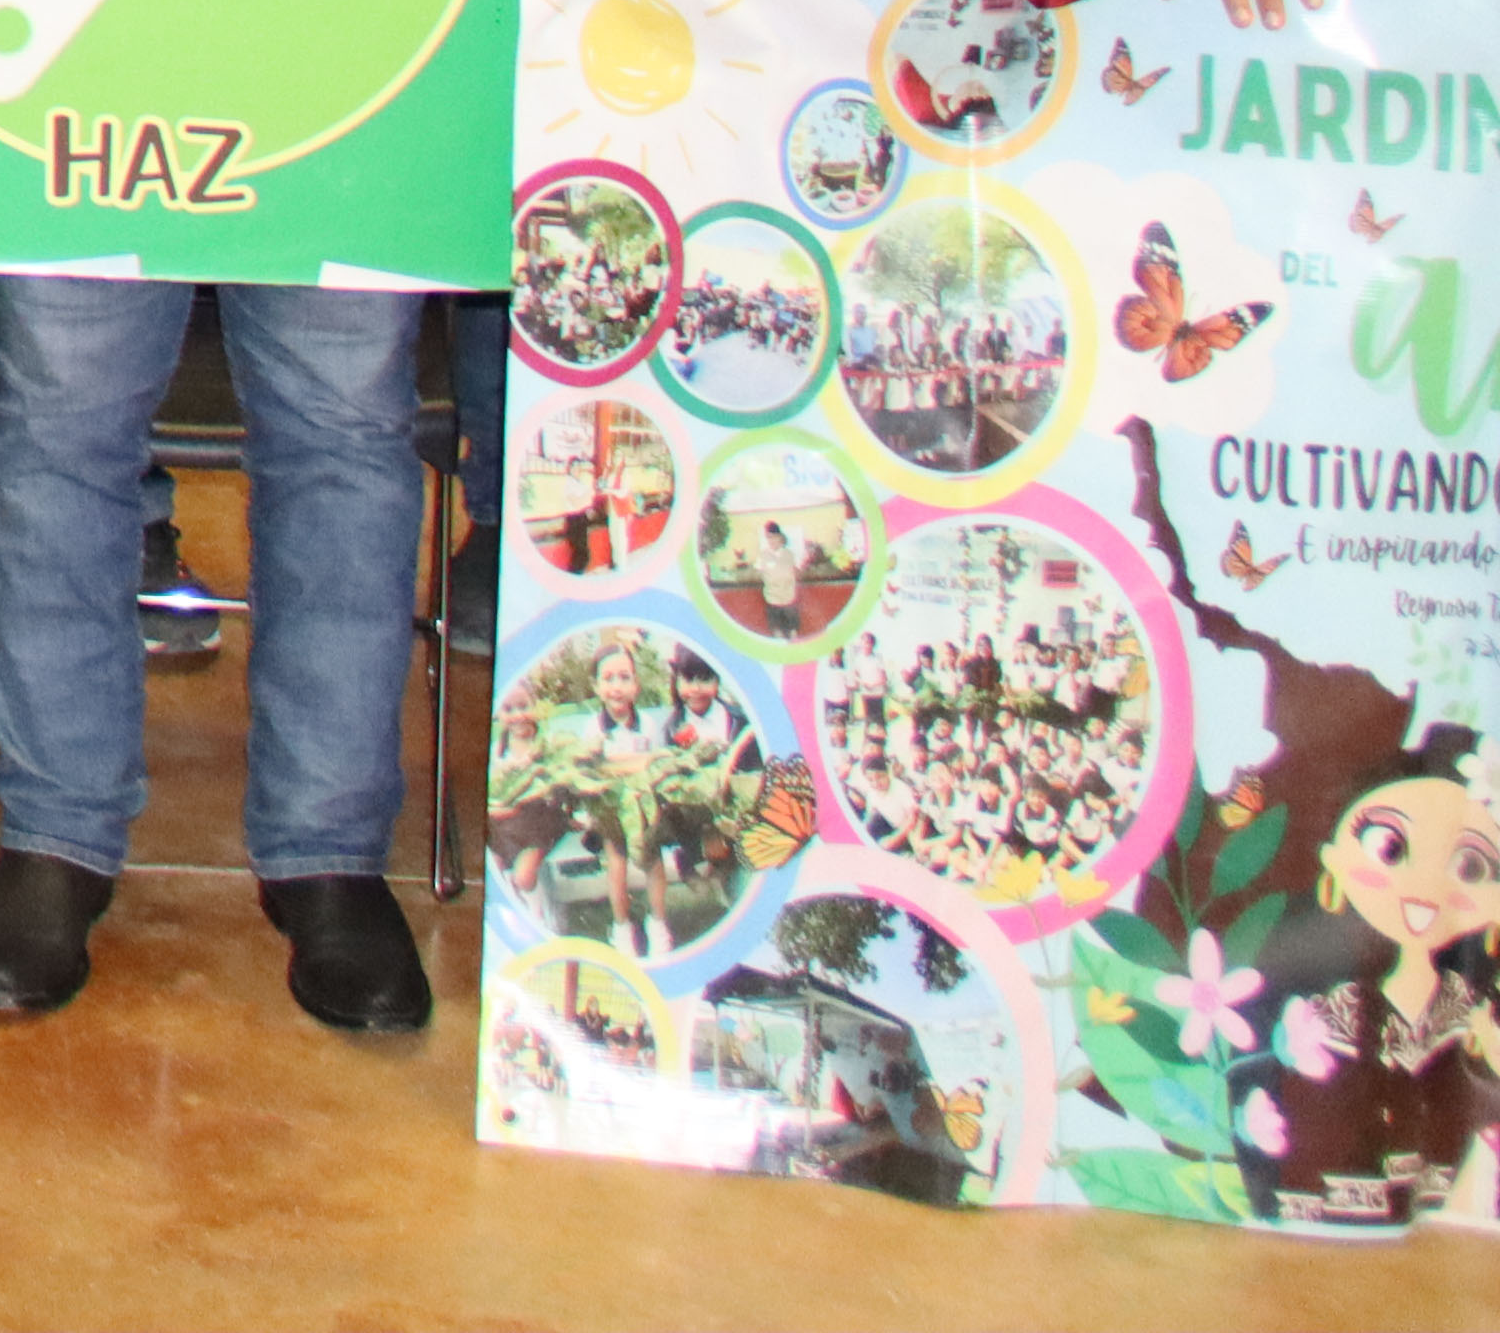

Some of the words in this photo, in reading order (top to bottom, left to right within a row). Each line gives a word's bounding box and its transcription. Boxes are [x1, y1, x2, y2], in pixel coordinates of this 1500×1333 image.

[49, 112, 252, 207] HAZ
[1280, 250, 1338, 288] DEL
[1211, 434, 1500, 513] CULTiVAND
